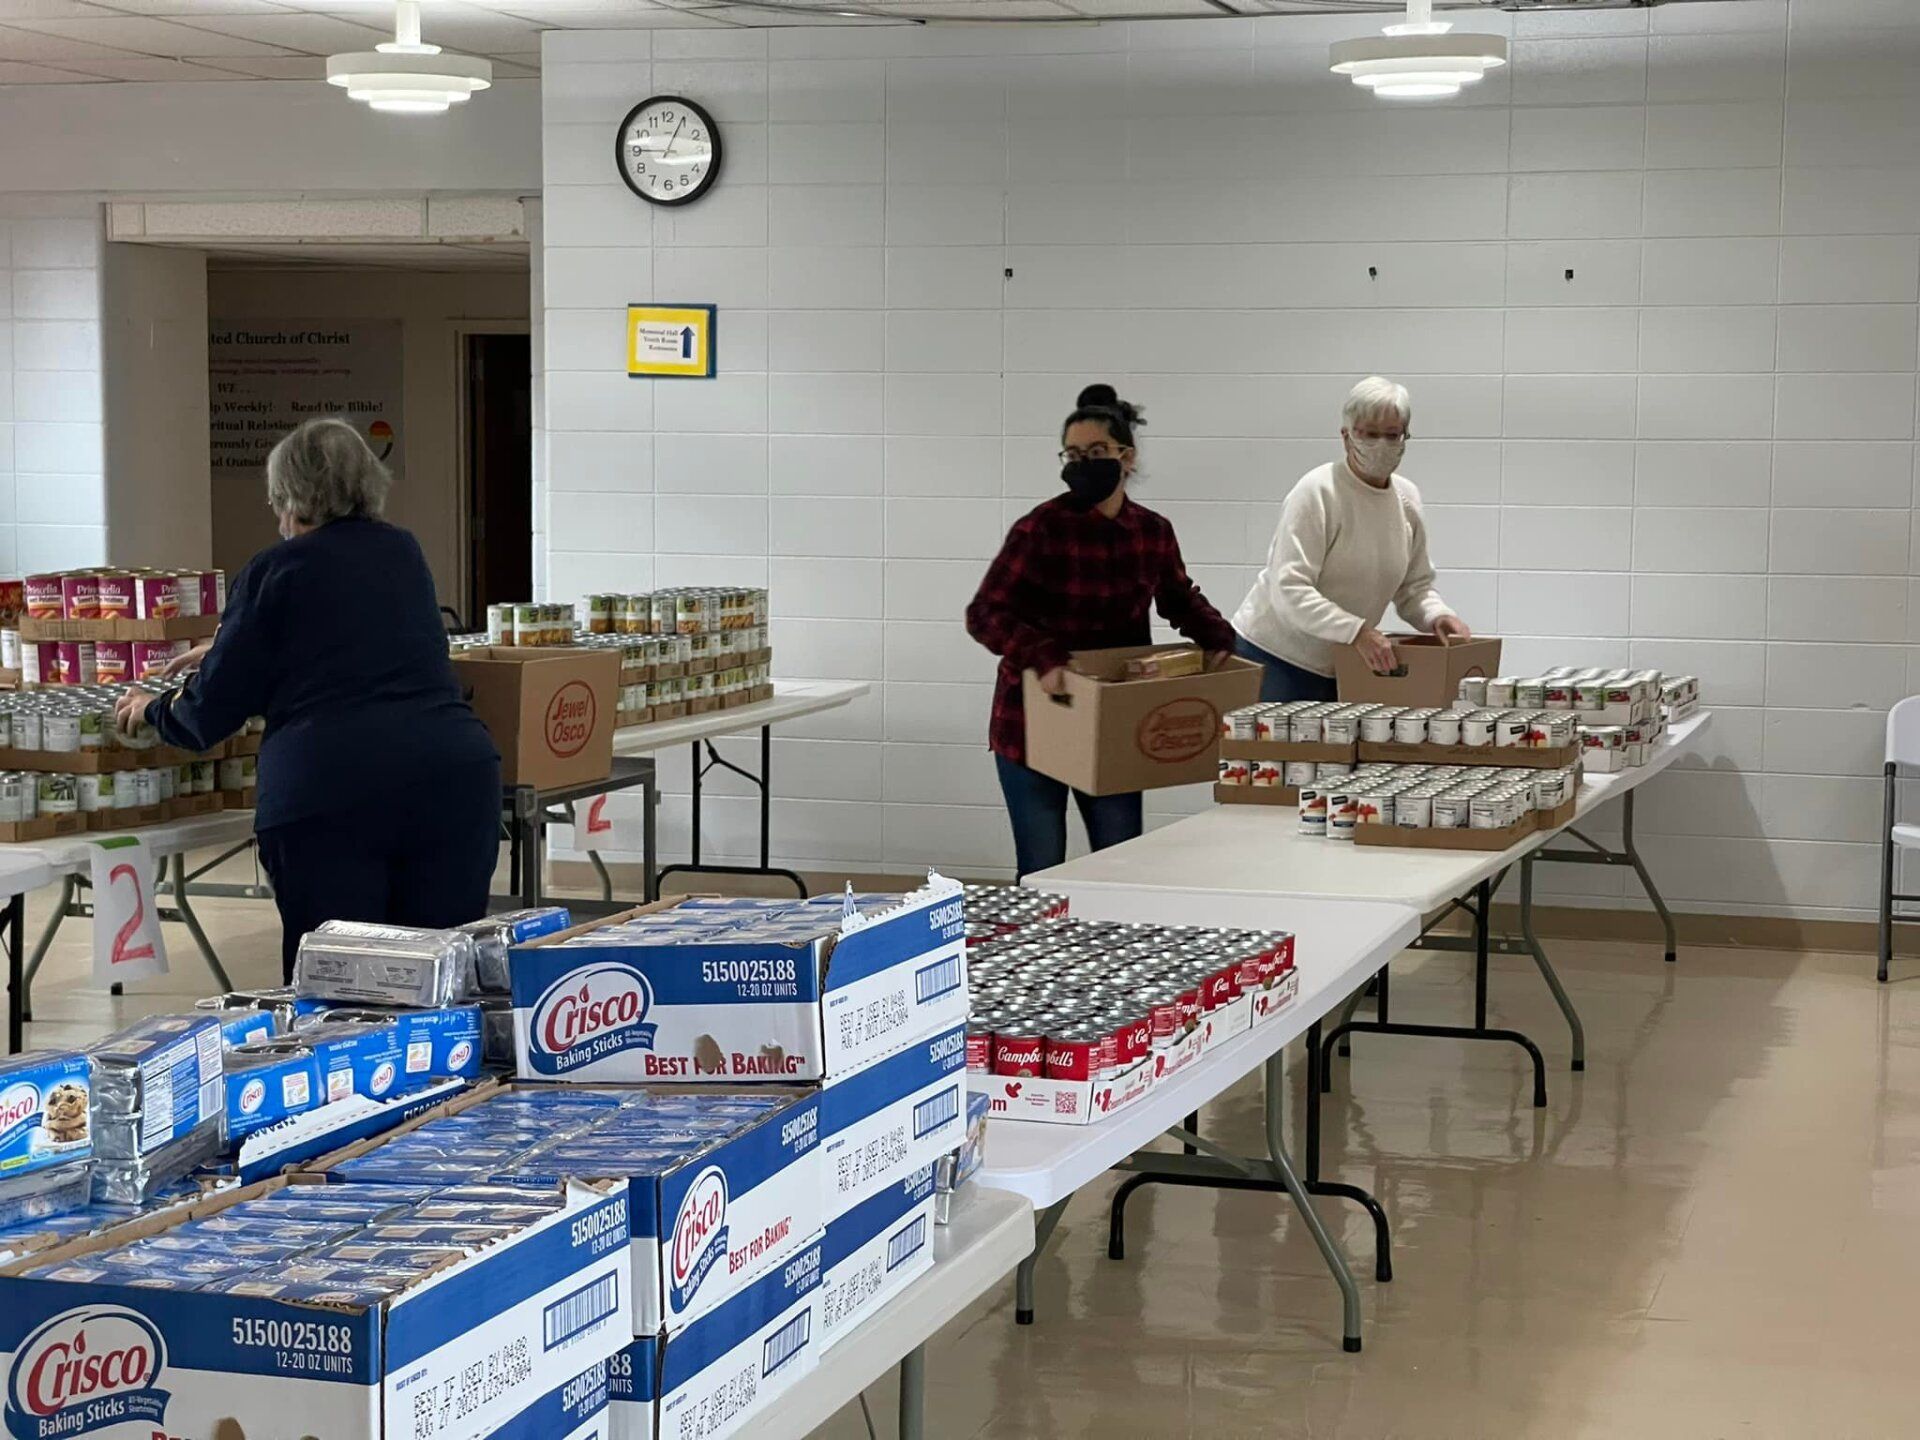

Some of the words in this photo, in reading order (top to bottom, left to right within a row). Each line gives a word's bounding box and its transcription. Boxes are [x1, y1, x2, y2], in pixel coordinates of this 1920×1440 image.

[649, 117, 658, 128] 11
[662, 111, 674, 123] 12
[637, 129, 650, 139] 10
[691, 129, 700, 140] 2
[632, 145, 642, 157] 9
[637, 162, 646, 174] 8
[691, 163, 700, 173] 4
[648, 175, 657, 187] 7
[663, 179, 673, 191] 6
[680, 174, 689, 186] 5
[236, 331, 286, 345] Church
[290, 331, 304, 345] of
[307, 331, 350, 345] Christ
[225, 401, 273, 414] Weekly!
[291, 401, 321, 412] Read
[325, 401, 344, 412] the
[349, 401, 383, 412] Bible!
[553, 694, 589, 720] Jewel
[553, 721, 585, 744] Osco
[110, 864, 155, 964] 2
[702, 959, 796, 983] 5150025188
[737, 983, 759, 996] 12-20
[762, 983, 773, 996] OZ
[774, 982, 798, 997] UNITS
[544, 983, 638, 1052] Crisco
[556, 1044, 592, 1071] Baking
[593, 1033, 623, 1055] Sticks
[645, 1054, 688, 1076] BEST
[572, 1198, 627, 1248] 5150025188
[676, 1190, 719, 1280] Crisco
[729, 1245, 747, 1275] BEST
[750, 1235, 763, 1261] FOR
[232, 1317, 352, 1354] 5150025188
[276, 1351, 305, 1370] 12-20
[308, 1354, 322, 1371] OZ
[323, 1355, 353, 1374] UNITS
[27, 1329, 148, 1416] Crisco
[39, 1410, 84, 1439] Baking
[86, 1399, 124, 1425] Sticks
